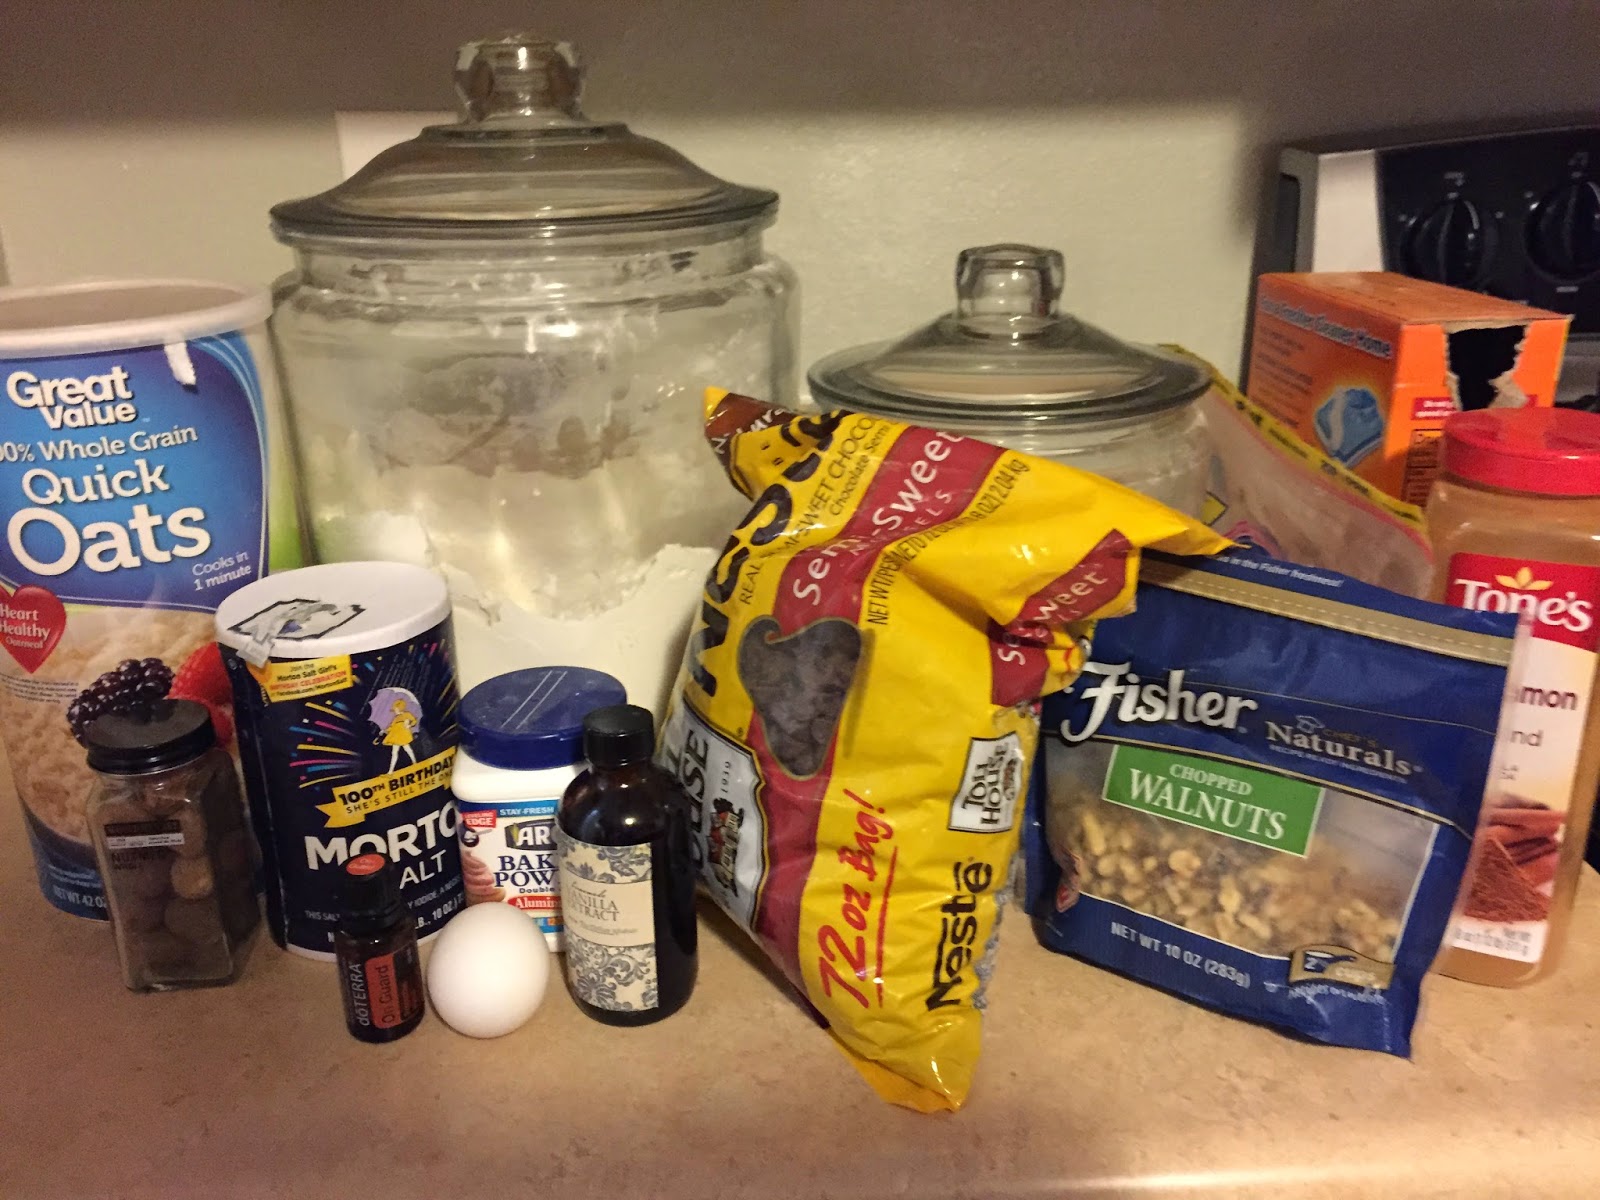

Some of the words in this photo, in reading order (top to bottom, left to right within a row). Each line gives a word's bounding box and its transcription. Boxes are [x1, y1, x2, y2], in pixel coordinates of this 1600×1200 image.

[7, 366, 134, 408] Great
[40, 402, 138, 430] Value
[0, 442, 35, 463] 0%
[38, 437, 127, 461] Whole
[129, 425, 199, 452] Grain
[22, 459, 171, 505] Quick
[828, 454, 870, 516] Chocolate
[739, 563, 763, 605] REAL
[828, 416, 878, 480] CHOCO
[7, 504, 212, 576] Oats
[867, 600, 889, 626] NET
[1010, 458, 1031, 476] kg
[192, 554, 234, 577] Cooks
[235, 550, 250, 564] in
[194, 578, 203, 591] 1
[205, 564, 252, 588] minute
[0, 603, 39, 621] Heart
[1454, 578, 1594, 633] Tone's
[0, 620, 51, 641] Healthy
[1061, 660, 1259, 743] Fisher
[1265, 720, 1413, 776] Naturals
[338, 782, 386, 807] 100TH
[388, 755, 454, 792] BIRTHDAY
[346, 797, 381, 814] SHE'S
[385, 786, 415, 804] STILL
[417, 776, 437, 791] THE
[961, 763, 989, 809] TOLL
[981, 742, 1010, 825] HOUSE
[1169, 763, 1253, 796] CHOPPED
[466, 817, 493, 826] EDGE
[1130, 768, 1288, 840] WALNUTS
[304, 801, 459, 871] MORTO
[516, 826, 552, 847] AR
[838, 788, 894, 882] Bag!
[399, 849, 446, 890] ALT
[494, 869, 560, 888] POW
[498, 853, 557, 872] BAK
[515, 896, 561, 910] Alumin
[519, 886, 556, 894] Double
[841, 883, 872, 931] oz
[567, 901, 620, 922] TRACT
[818, 924, 870, 1009] 72
[1111, 921, 1137, 943] NET
[1139, 931, 1160, 954] WT
[1164, 942, 1181, 960] 10
[1183, 949, 1202, 969] OZ
[1204, 958, 1251, 990] (283g)
[374, 964, 393, 1005] Guard
